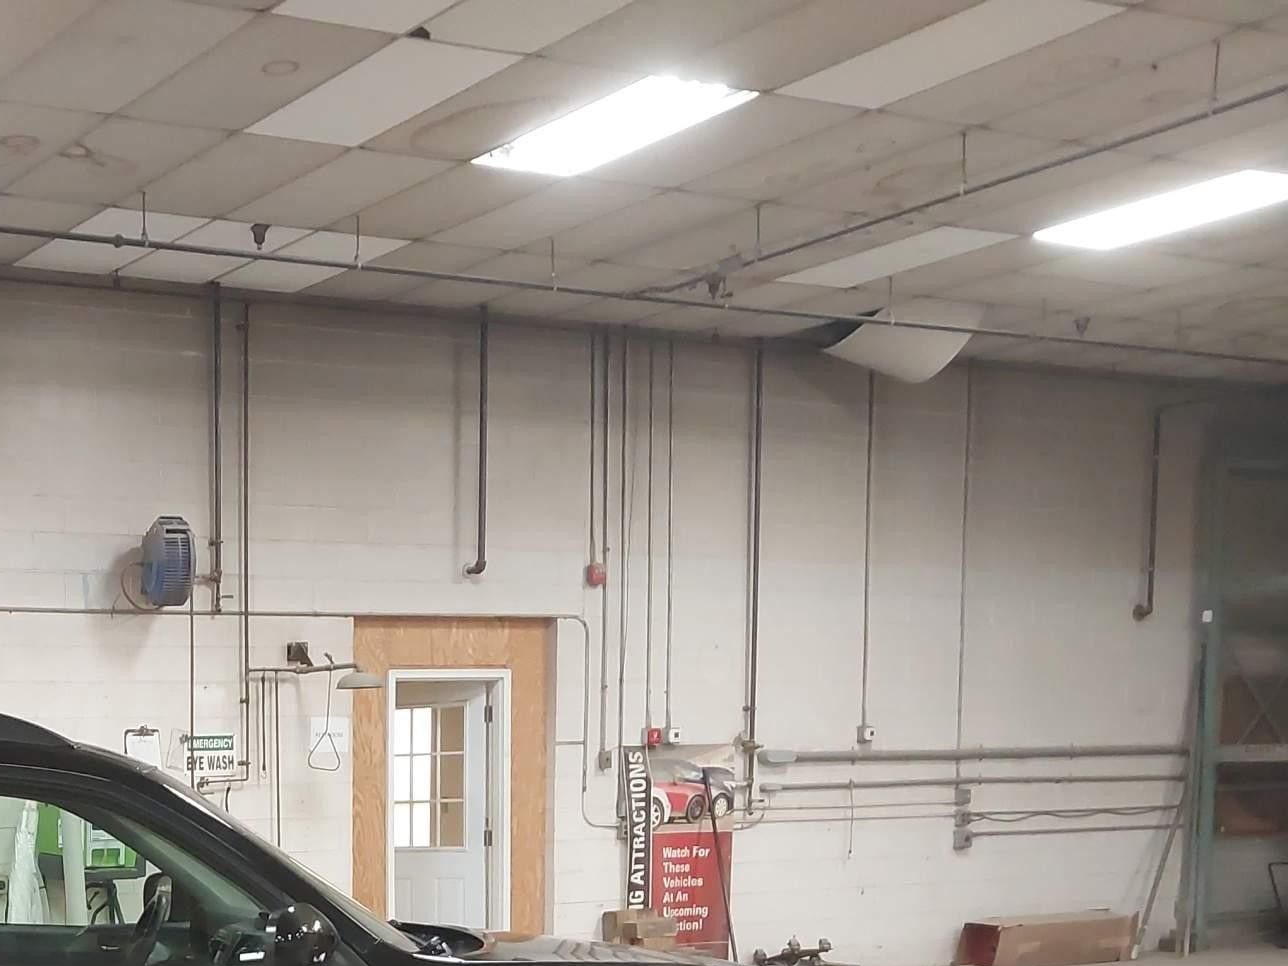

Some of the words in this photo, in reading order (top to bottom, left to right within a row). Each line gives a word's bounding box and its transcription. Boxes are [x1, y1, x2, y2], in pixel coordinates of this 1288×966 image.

[186, 755, 205, 771] EYE
[207, 754, 234, 771] WASH
[629, 751, 647, 885] ATTRACTIONS
[662, 845, 690, 859] Watch
[692, 846, 711, 858] For
[662, 861, 690, 874] These
[663, 875, 703, 888] Vehicles
[662, 891, 673, 903] At
[675, 890, 688, 903] An
[663, 904, 708, 918] Upcoming
